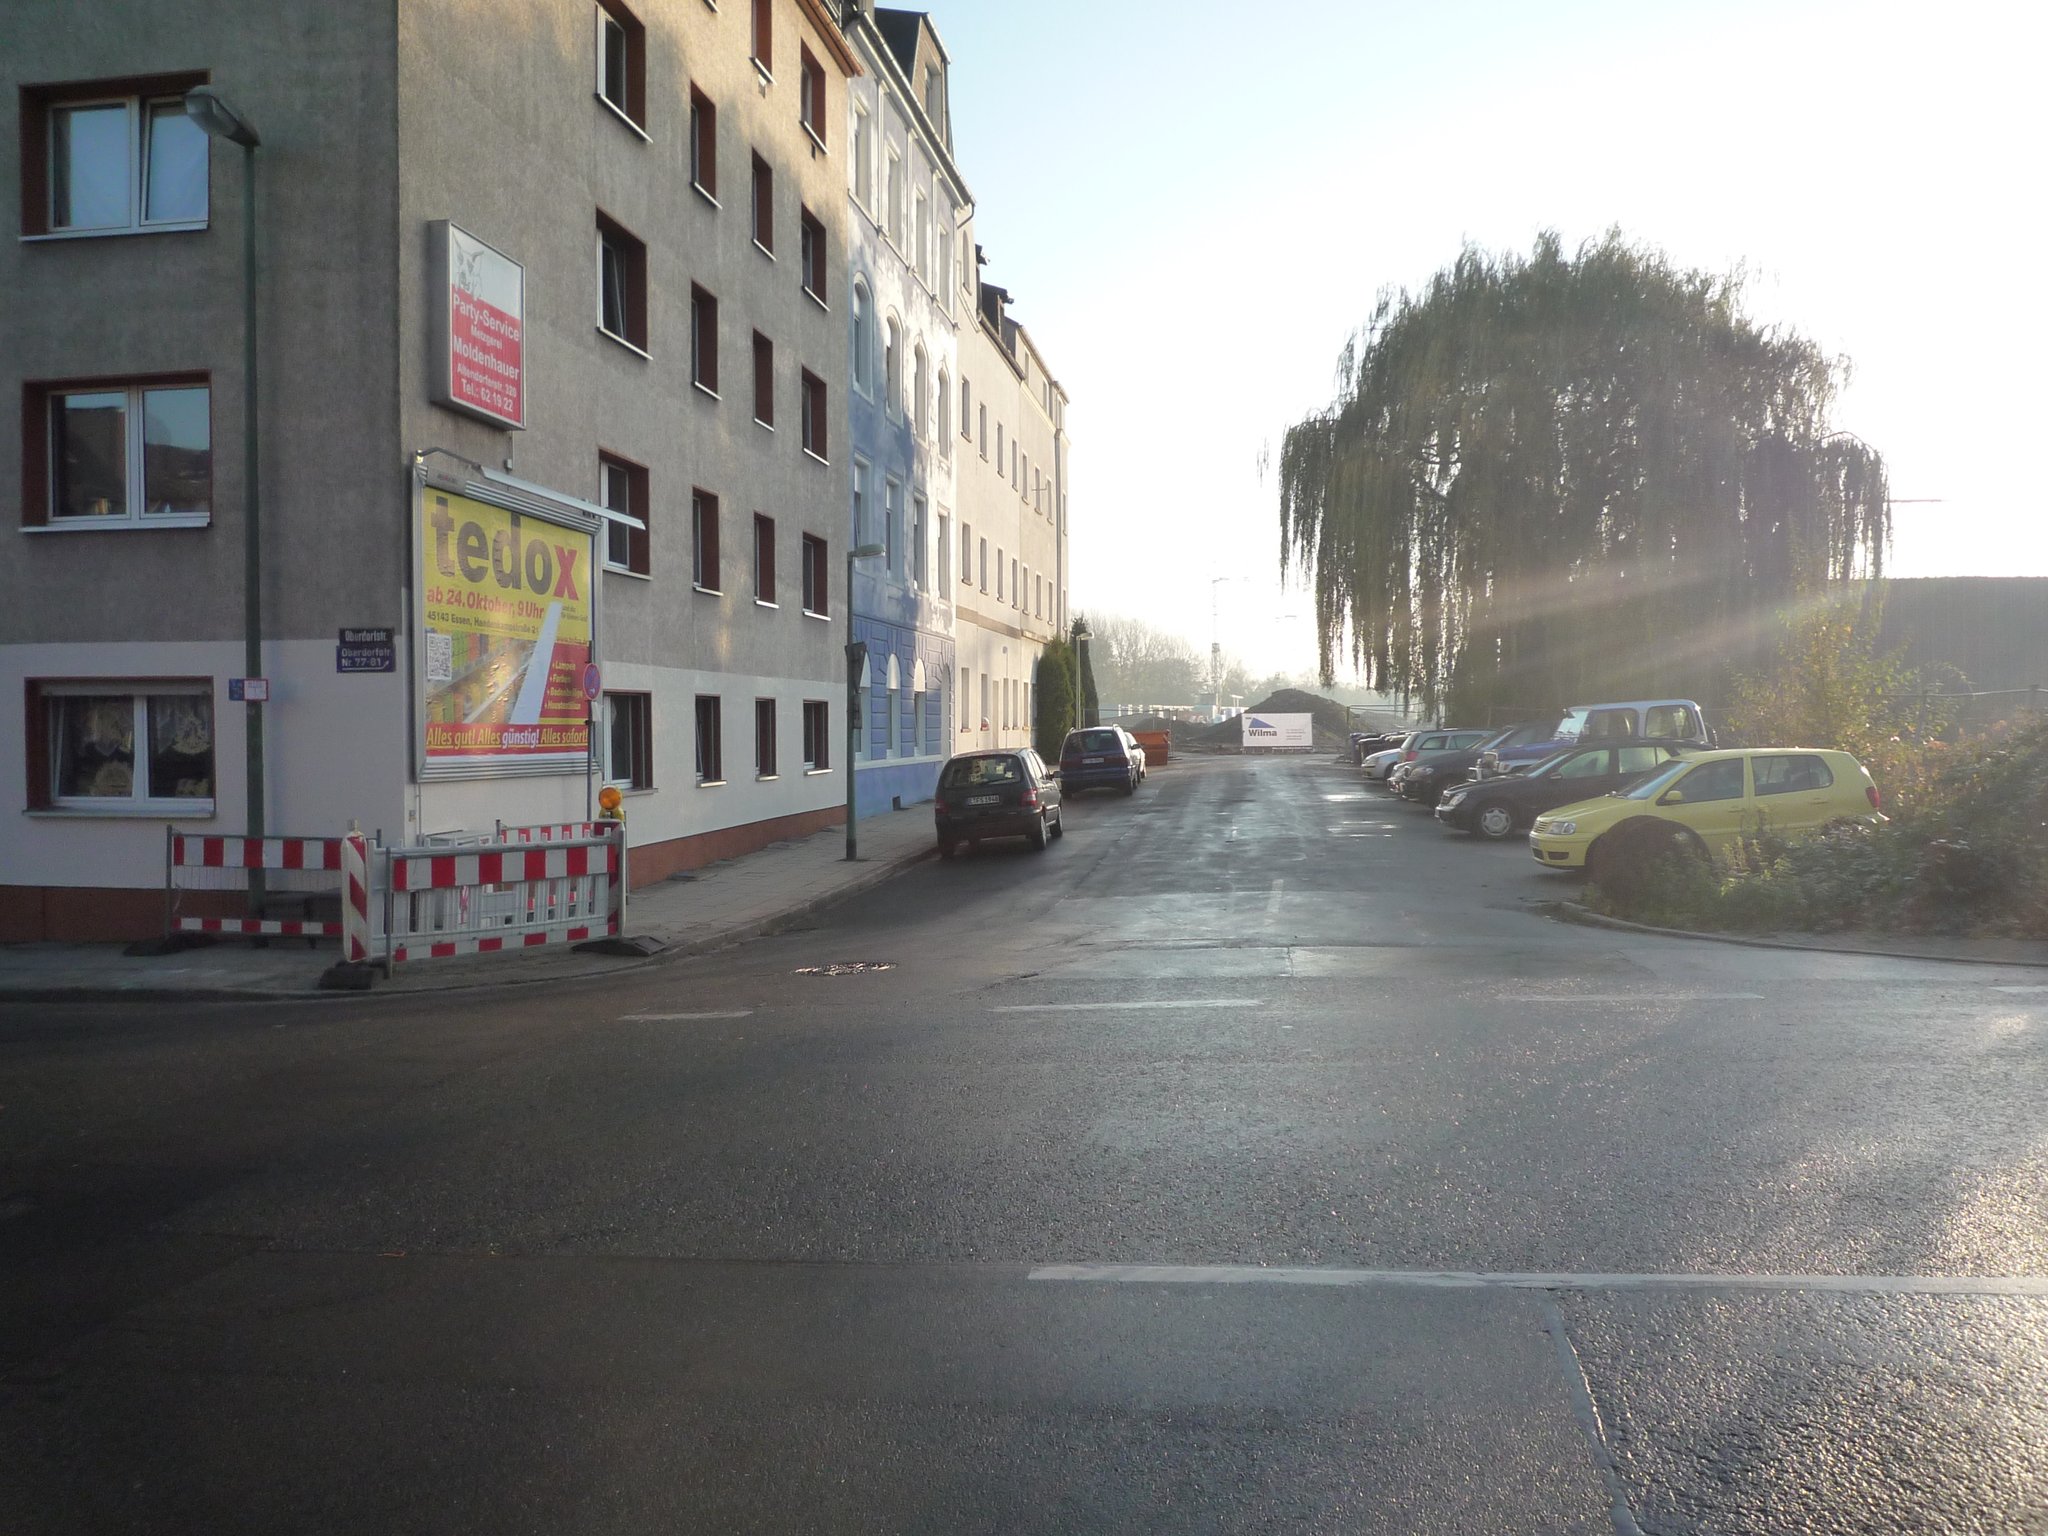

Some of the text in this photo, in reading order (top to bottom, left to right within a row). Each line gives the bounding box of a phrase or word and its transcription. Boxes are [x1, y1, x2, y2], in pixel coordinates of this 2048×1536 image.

[453, 294, 520, 342] Party-Service
[470, 324, 503, 350] Metzgerei
[453, 335, 519, 380] Moldenhauer
[480, 387, 490, 403] 62
[493, 392, 502, 407] 19
[504, 396, 514, 412] 22
[430, 495, 580, 601] tedox
[427, 586, 443, 604] ab
[427, 611, 449, 622] 45143
[451, 613, 472, 627] Essen,
[427, 727, 588, 750] Alles gut! Alles günstig! Alles sofort!
[1248, 729, 1278, 737] Wilma
